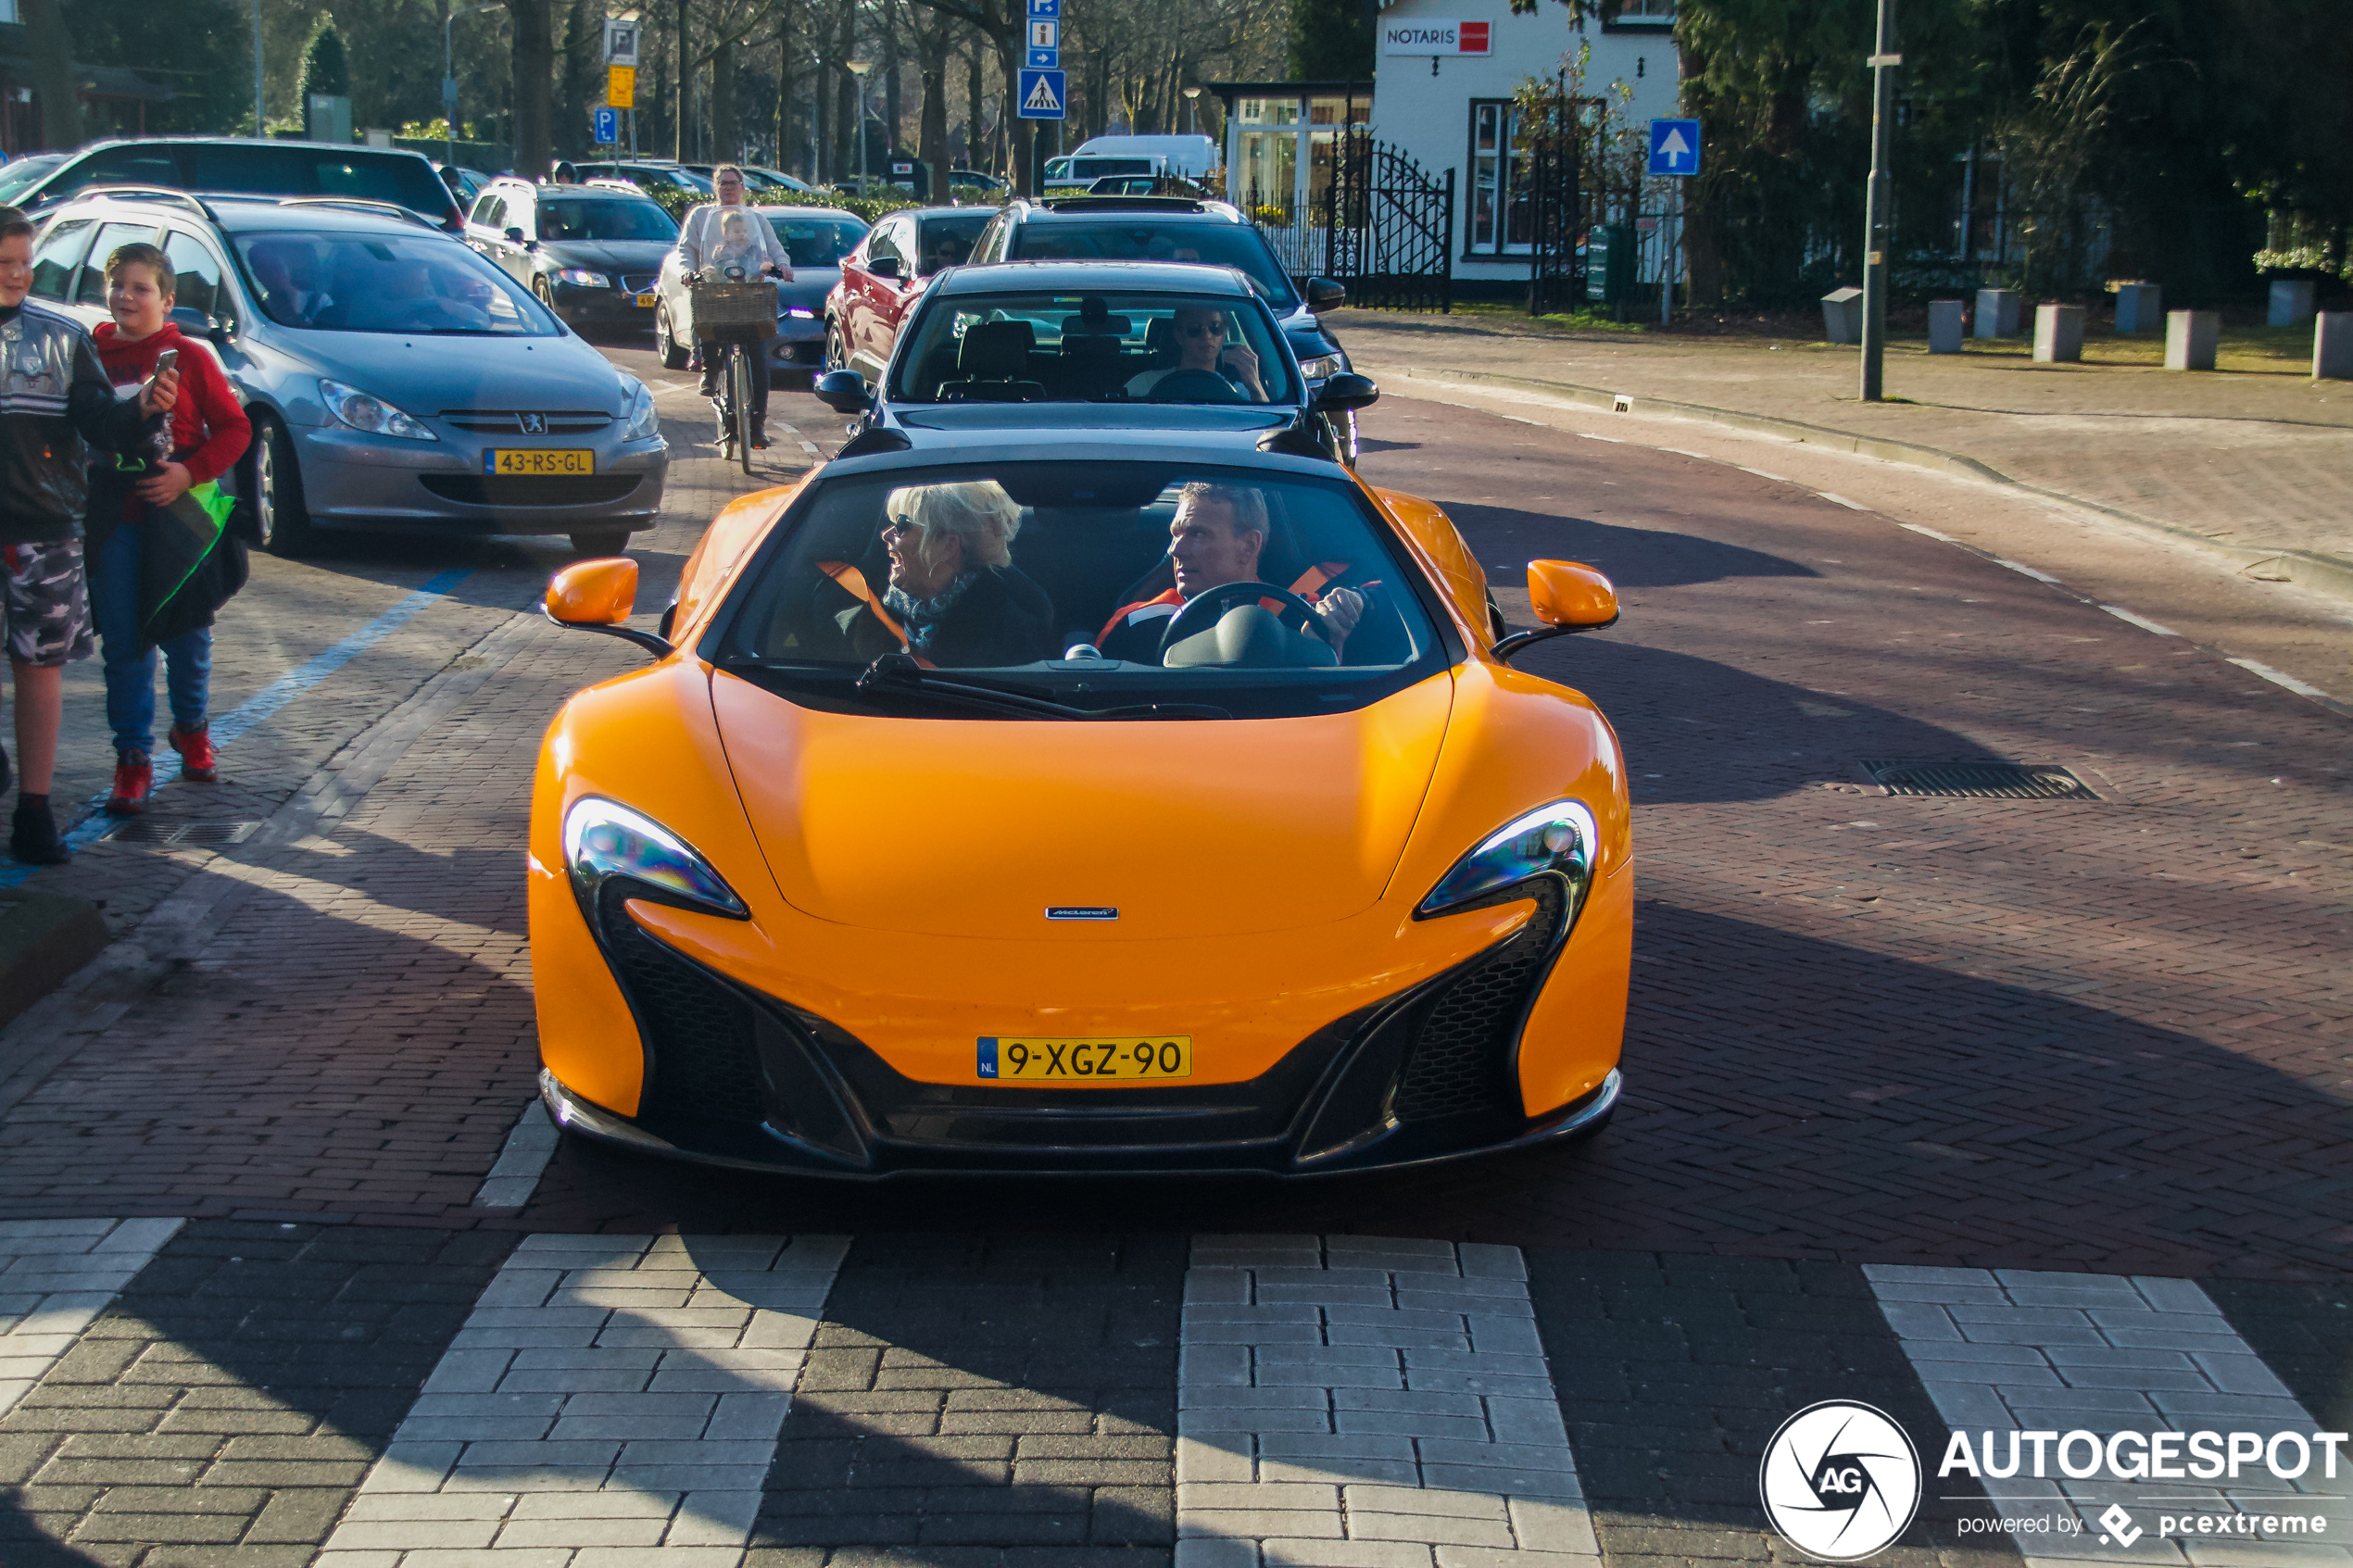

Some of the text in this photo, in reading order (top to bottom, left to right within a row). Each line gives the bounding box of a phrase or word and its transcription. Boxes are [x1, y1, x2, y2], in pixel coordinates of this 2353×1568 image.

[1387, 30, 1455, 44] NOTARIS
[599, 112, 611, 129] P
[501, 454, 586, 471] 43-RS-GL
[981, 1042, 1181, 1075] NL 9-XGZ-90
